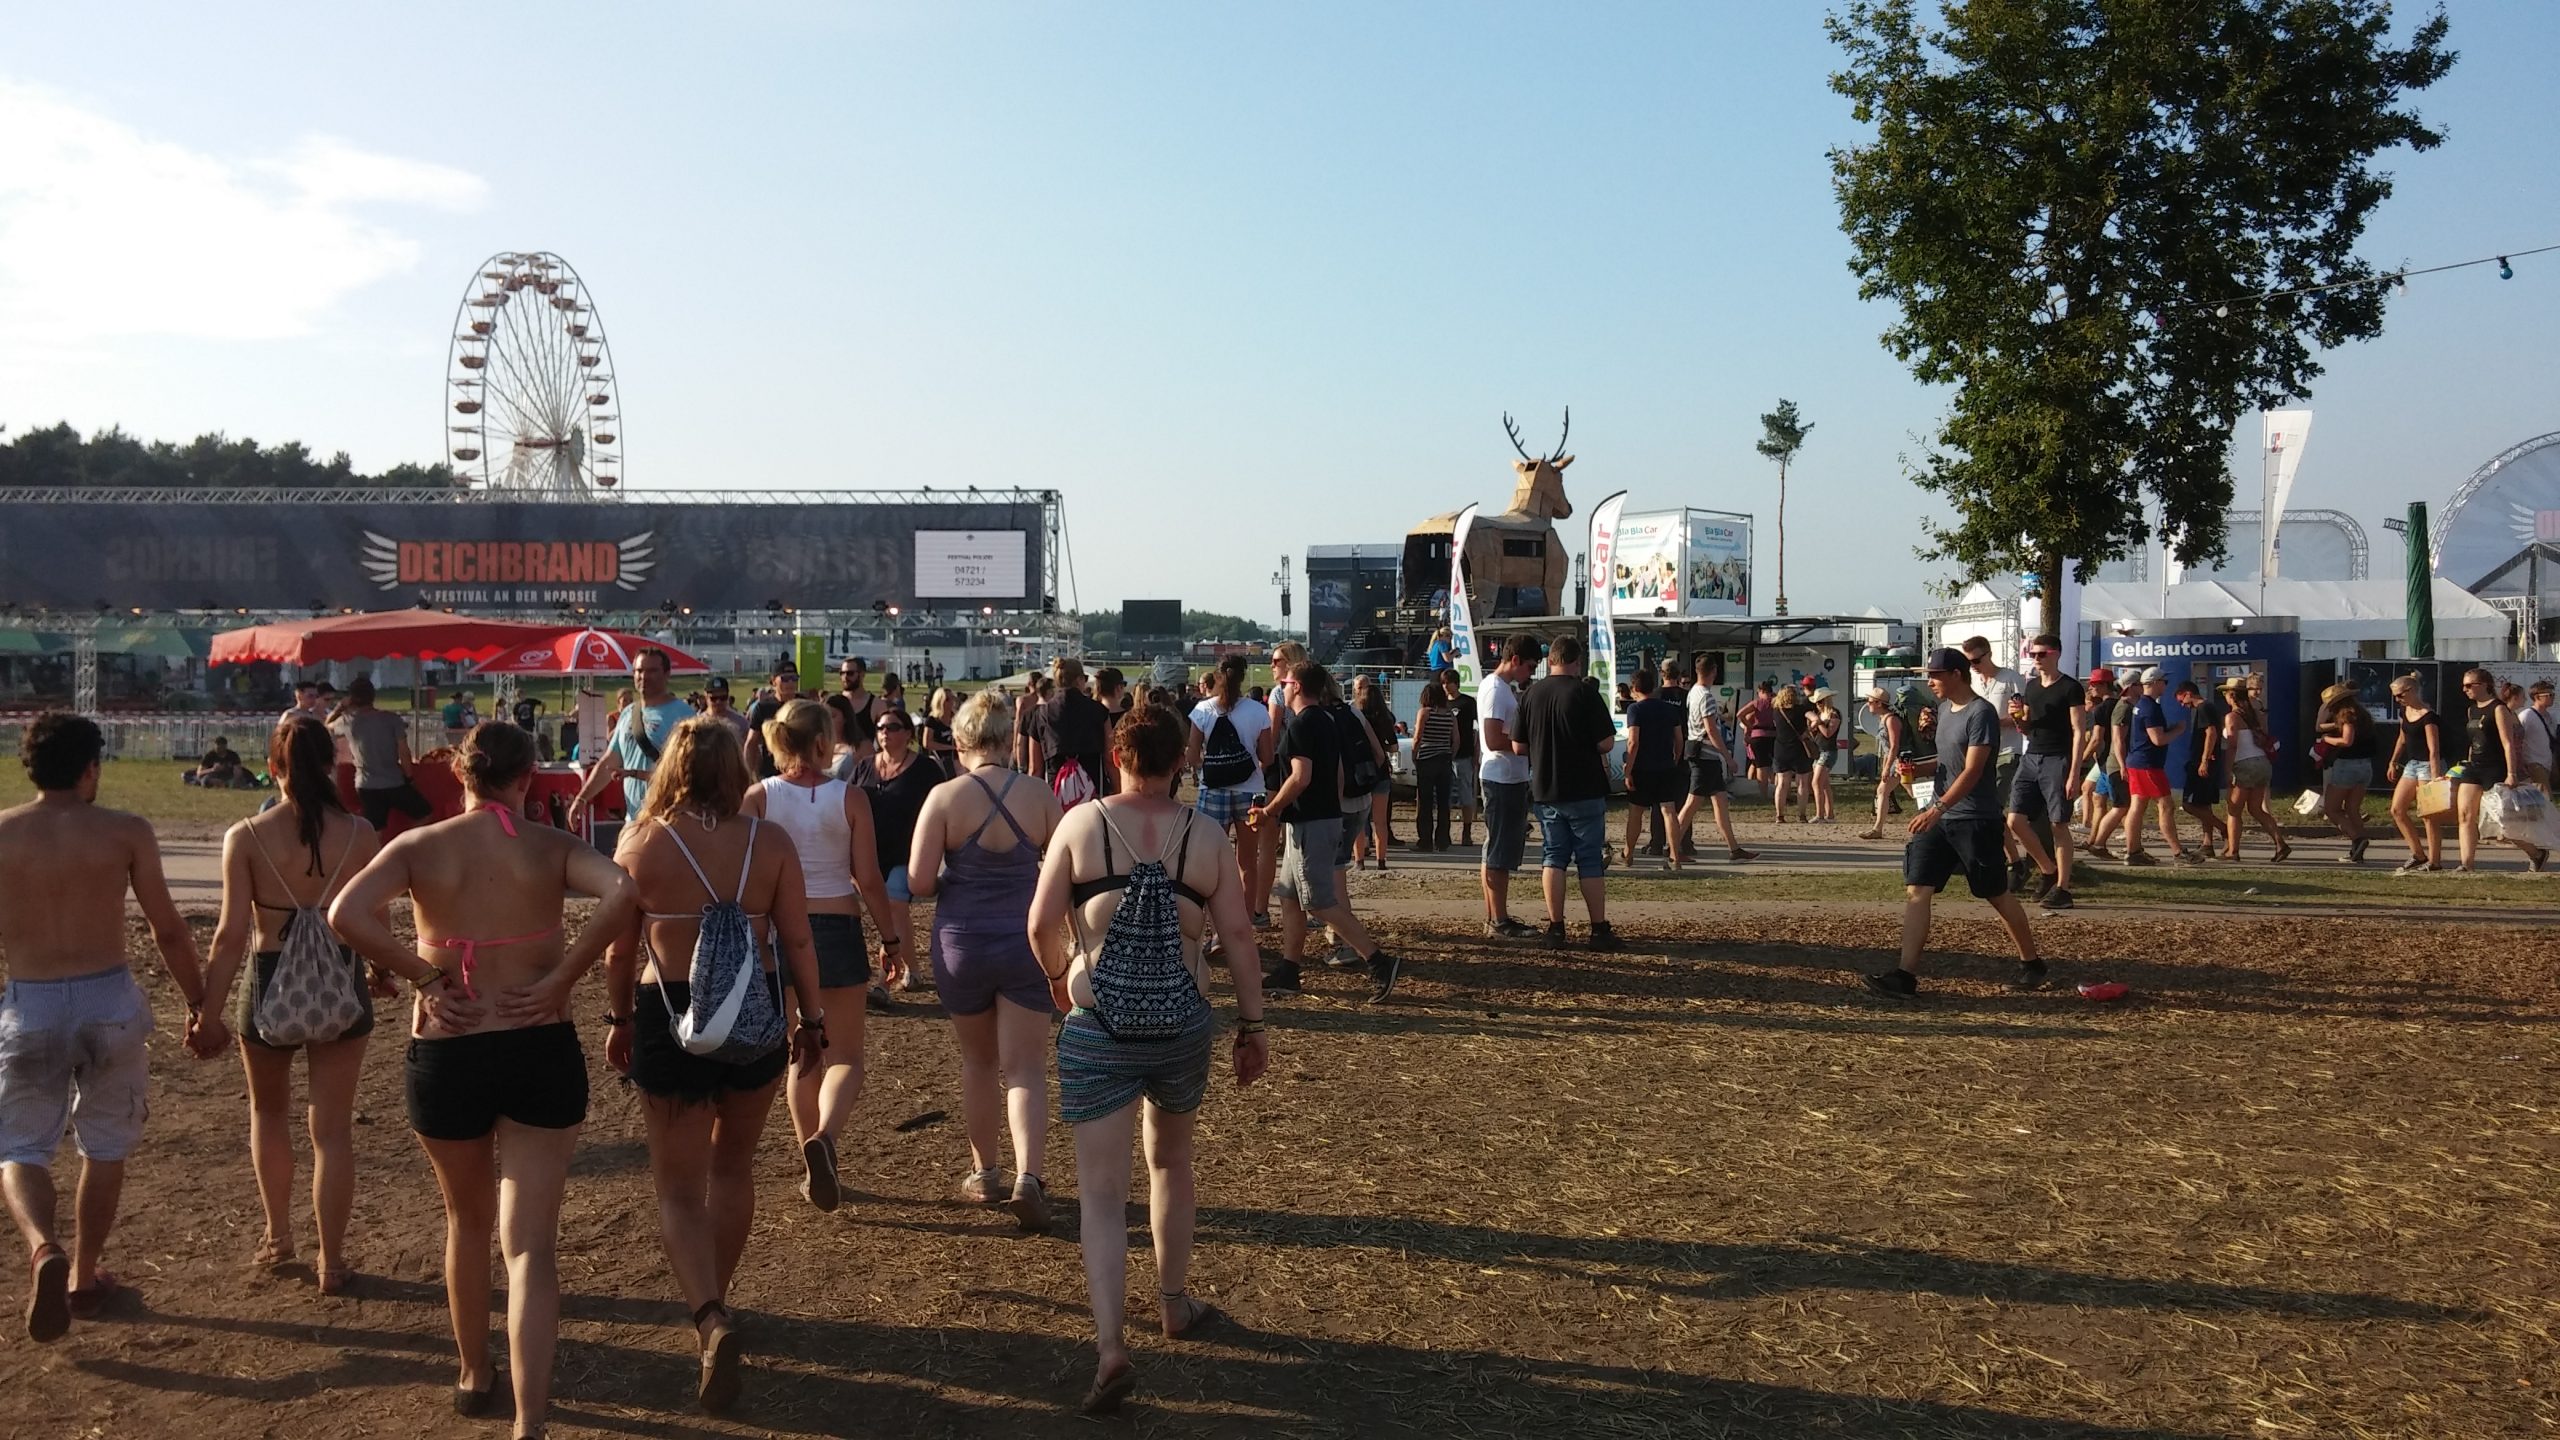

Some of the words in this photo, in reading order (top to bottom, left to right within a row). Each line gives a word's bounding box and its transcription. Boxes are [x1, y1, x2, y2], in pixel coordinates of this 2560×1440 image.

[1644, 526, 1658, 534] Car
[1723, 528, 1734, 537] Car
[1592, 523, 1611, 589] Car
[399, 541, 619, 584] DEICHBRAND
[954, 565, 980, 575] 04721
[954, 577, 986, 586] 573234
[434, 589, 489, 603] FESTIVAL
[494, 589, 510, 603] AN
[515, 589, 538, 603] DER
[2111, 639, 2249, 658] Geldautomat
